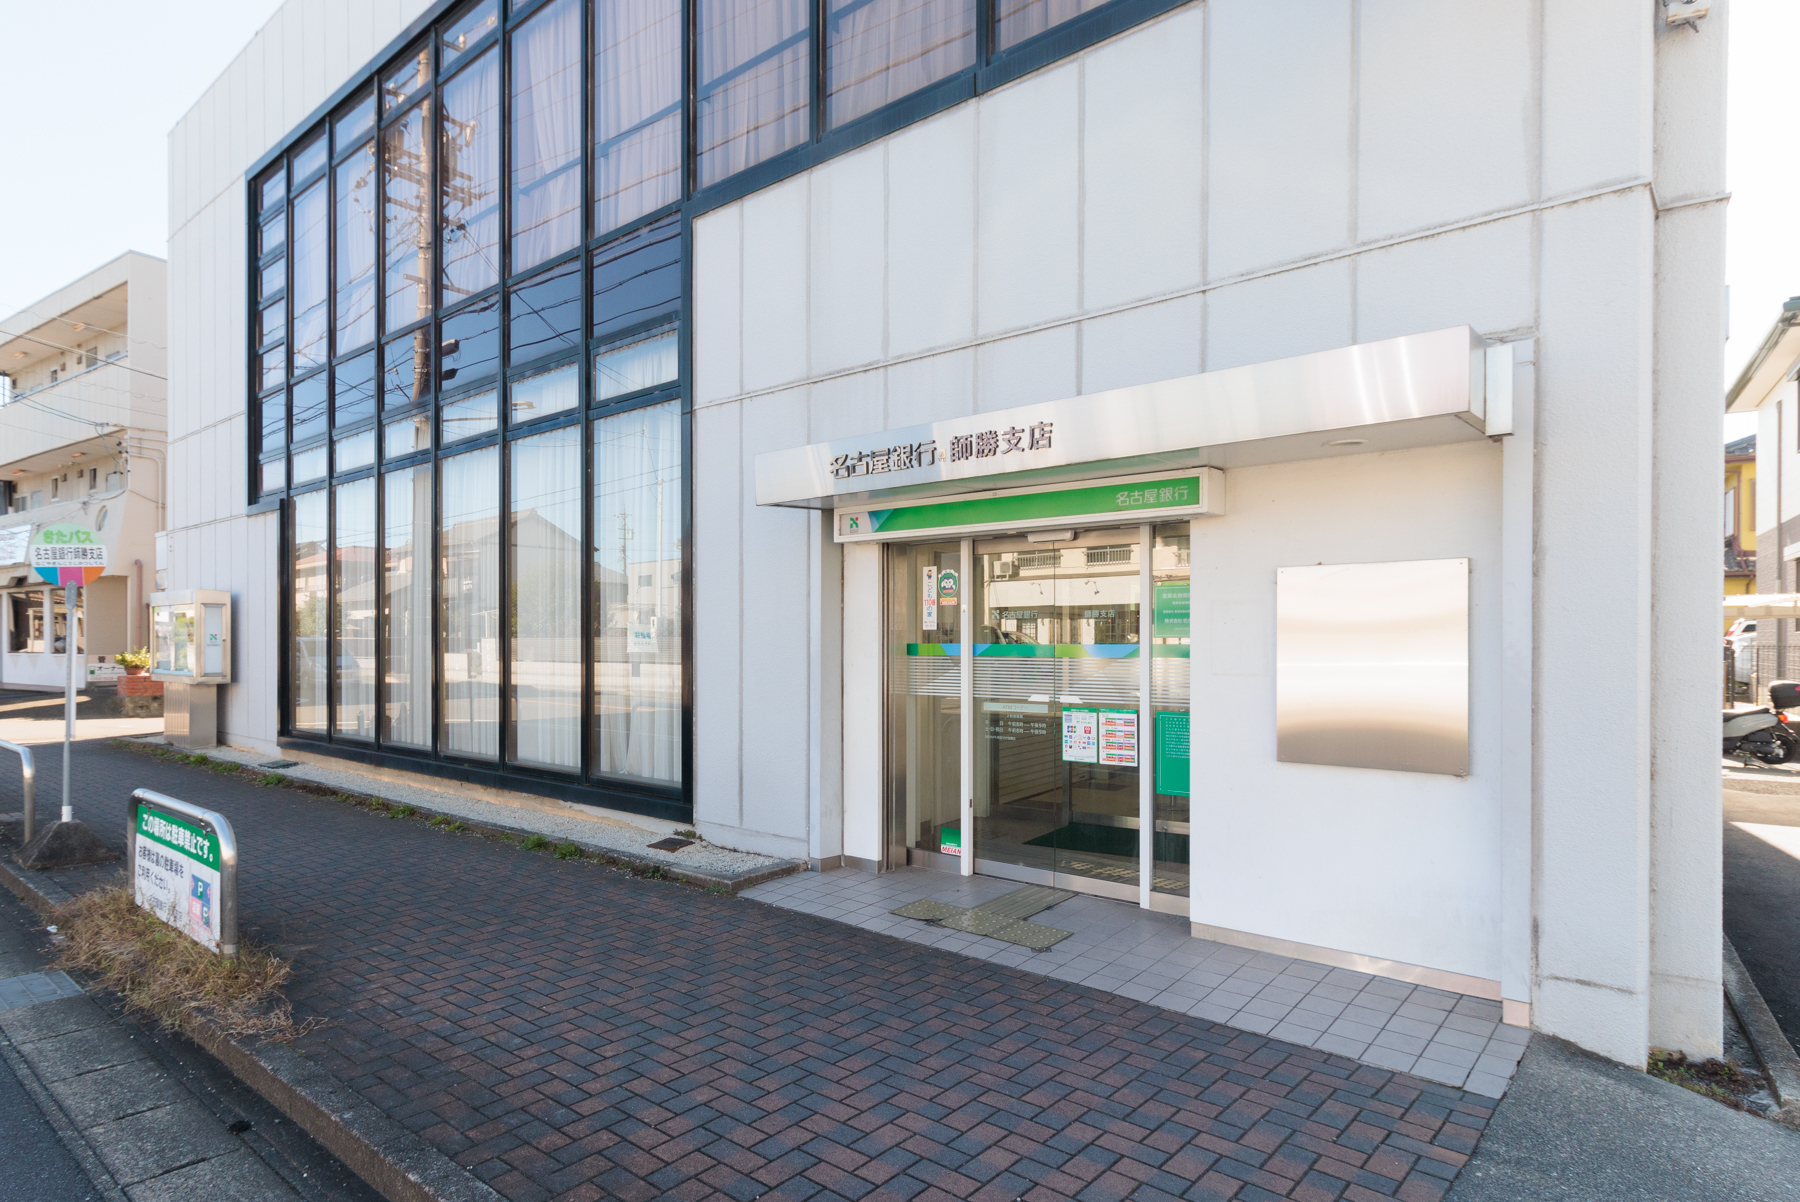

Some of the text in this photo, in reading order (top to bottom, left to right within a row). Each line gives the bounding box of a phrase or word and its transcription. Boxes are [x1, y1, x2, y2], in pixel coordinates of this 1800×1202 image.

[829, 420, 1053, 480] 名古屋銀行 師勝支店
[1115, 485, 1189, 506] 名古屋銀行
[43, 529, 94, 544] きたバス
[34, 546, 104, 560] 名古屋銀行師勝支店
[924, 580, 936, 618] こども110番の家
[1001, 609, 1116, 620] 名古屋銀行 師勝支店
[141, 813, 214, 862] この場所は駐車禁止です。
[941, 846, 961, 855] MEIAN
